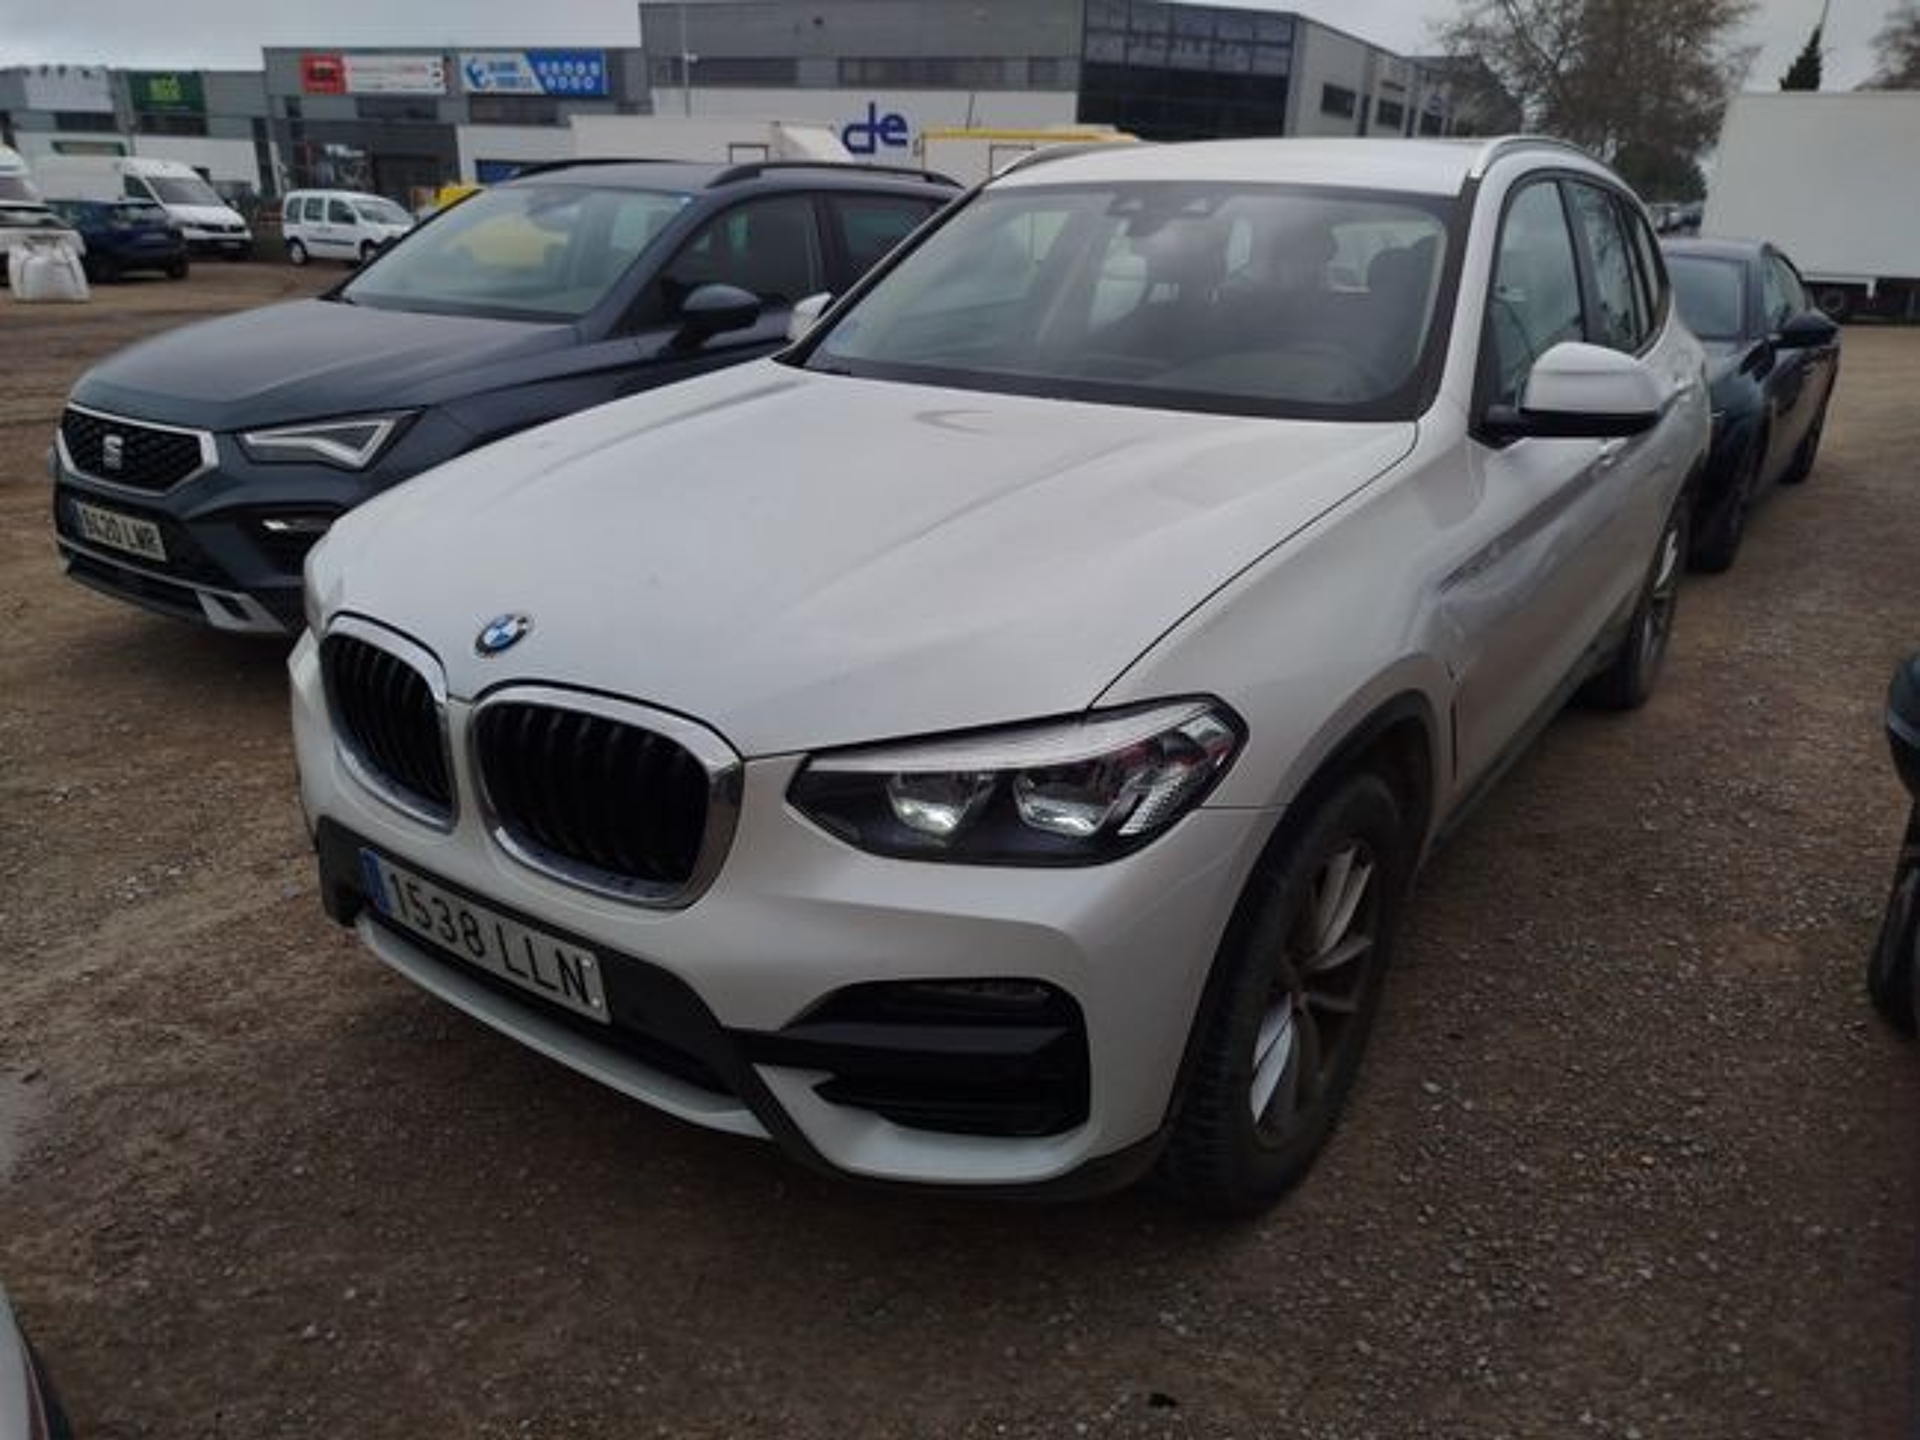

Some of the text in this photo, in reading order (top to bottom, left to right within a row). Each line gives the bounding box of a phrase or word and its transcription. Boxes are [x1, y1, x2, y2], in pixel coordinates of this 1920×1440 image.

[842, 101, 908, 155] de
[390, 873, 591, 1006] 1538 LLN
